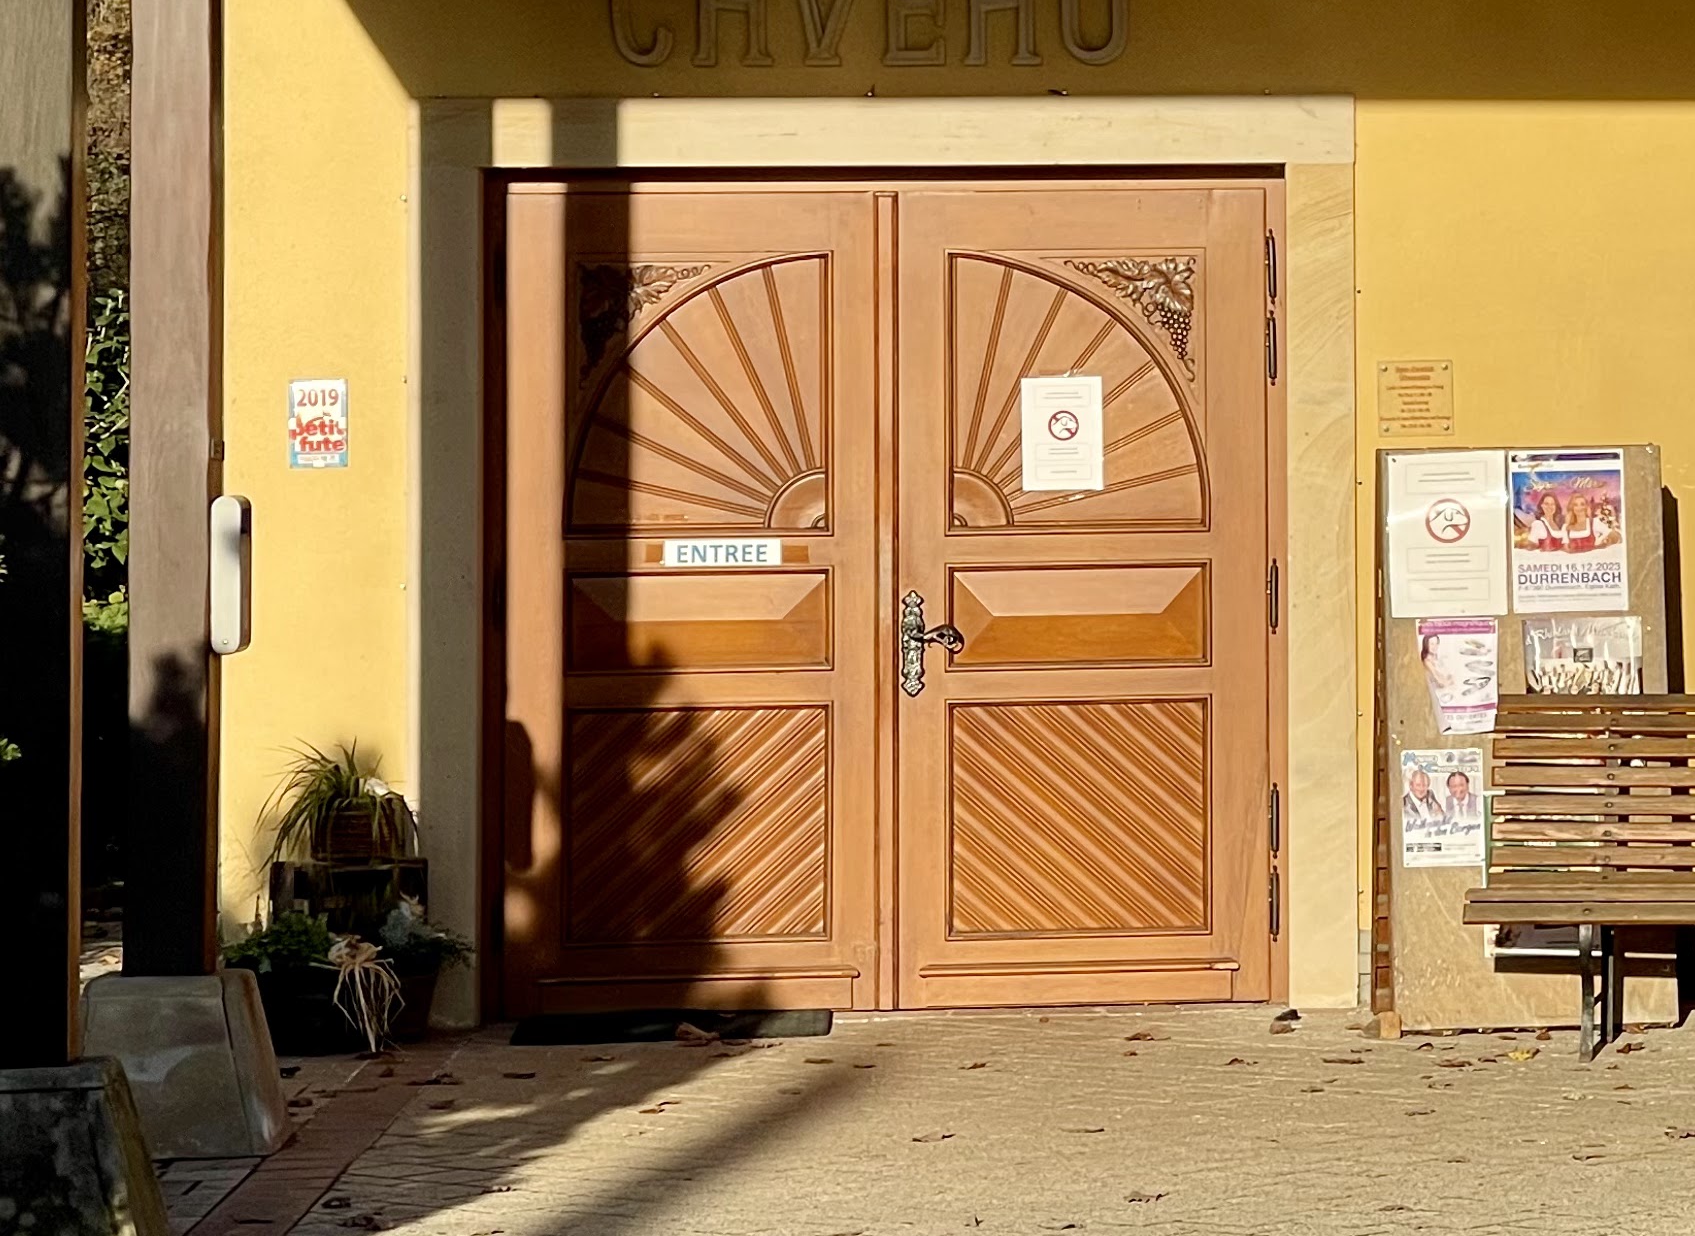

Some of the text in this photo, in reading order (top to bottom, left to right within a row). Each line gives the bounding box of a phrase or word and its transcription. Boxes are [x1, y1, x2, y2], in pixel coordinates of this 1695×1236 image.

[297, 389, 339, 406] 2019
[677, 544, 767, 563] ENTREE
[1518, 563, 1561, 573] SAMEDI
[1518, 571, 1621, 584] DURRENBACH
